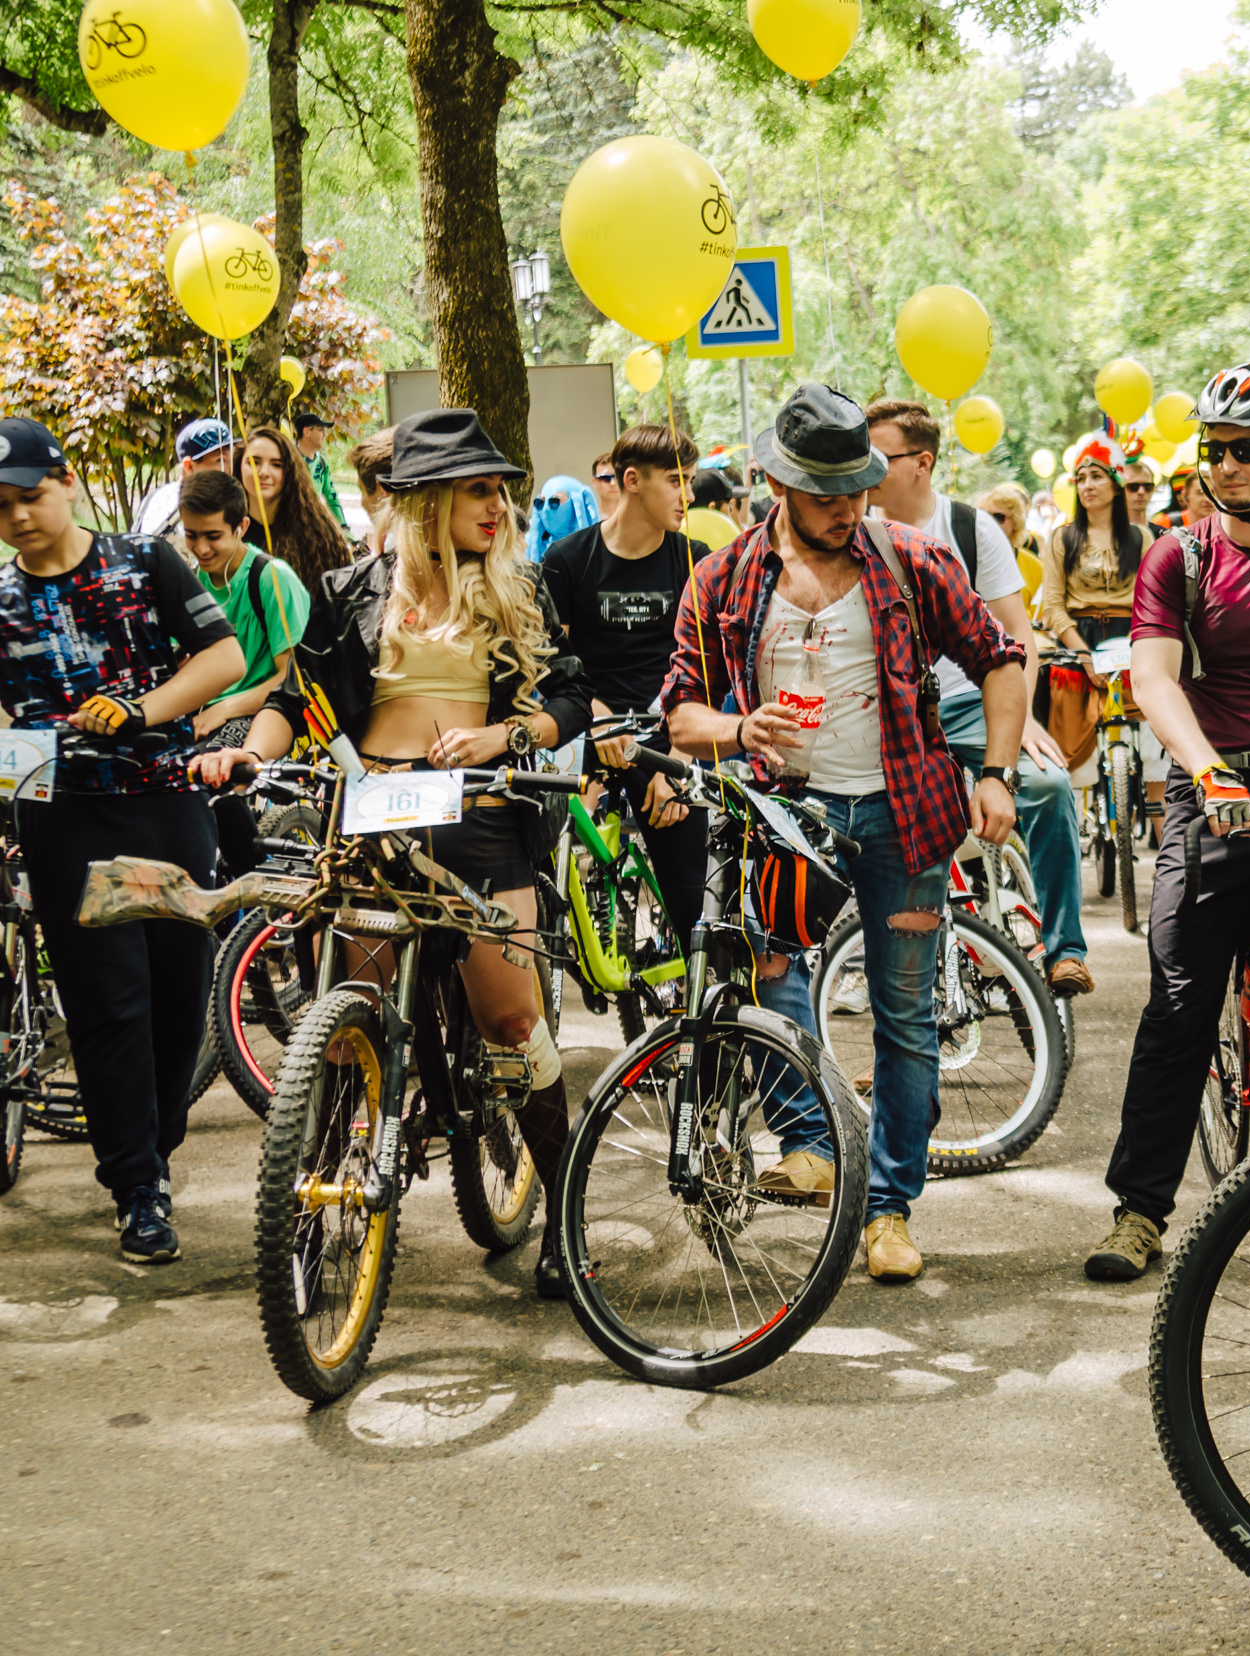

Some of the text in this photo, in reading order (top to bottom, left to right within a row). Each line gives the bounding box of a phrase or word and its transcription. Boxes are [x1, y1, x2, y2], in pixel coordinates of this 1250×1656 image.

[387, 792, 421, 812] 161
[378, 1115, 401, 1177] ROCKSHOX
[675, 1101, 694, 1157] ROCKSHOX
[832, 1104, 847, 1154] MARATHON
